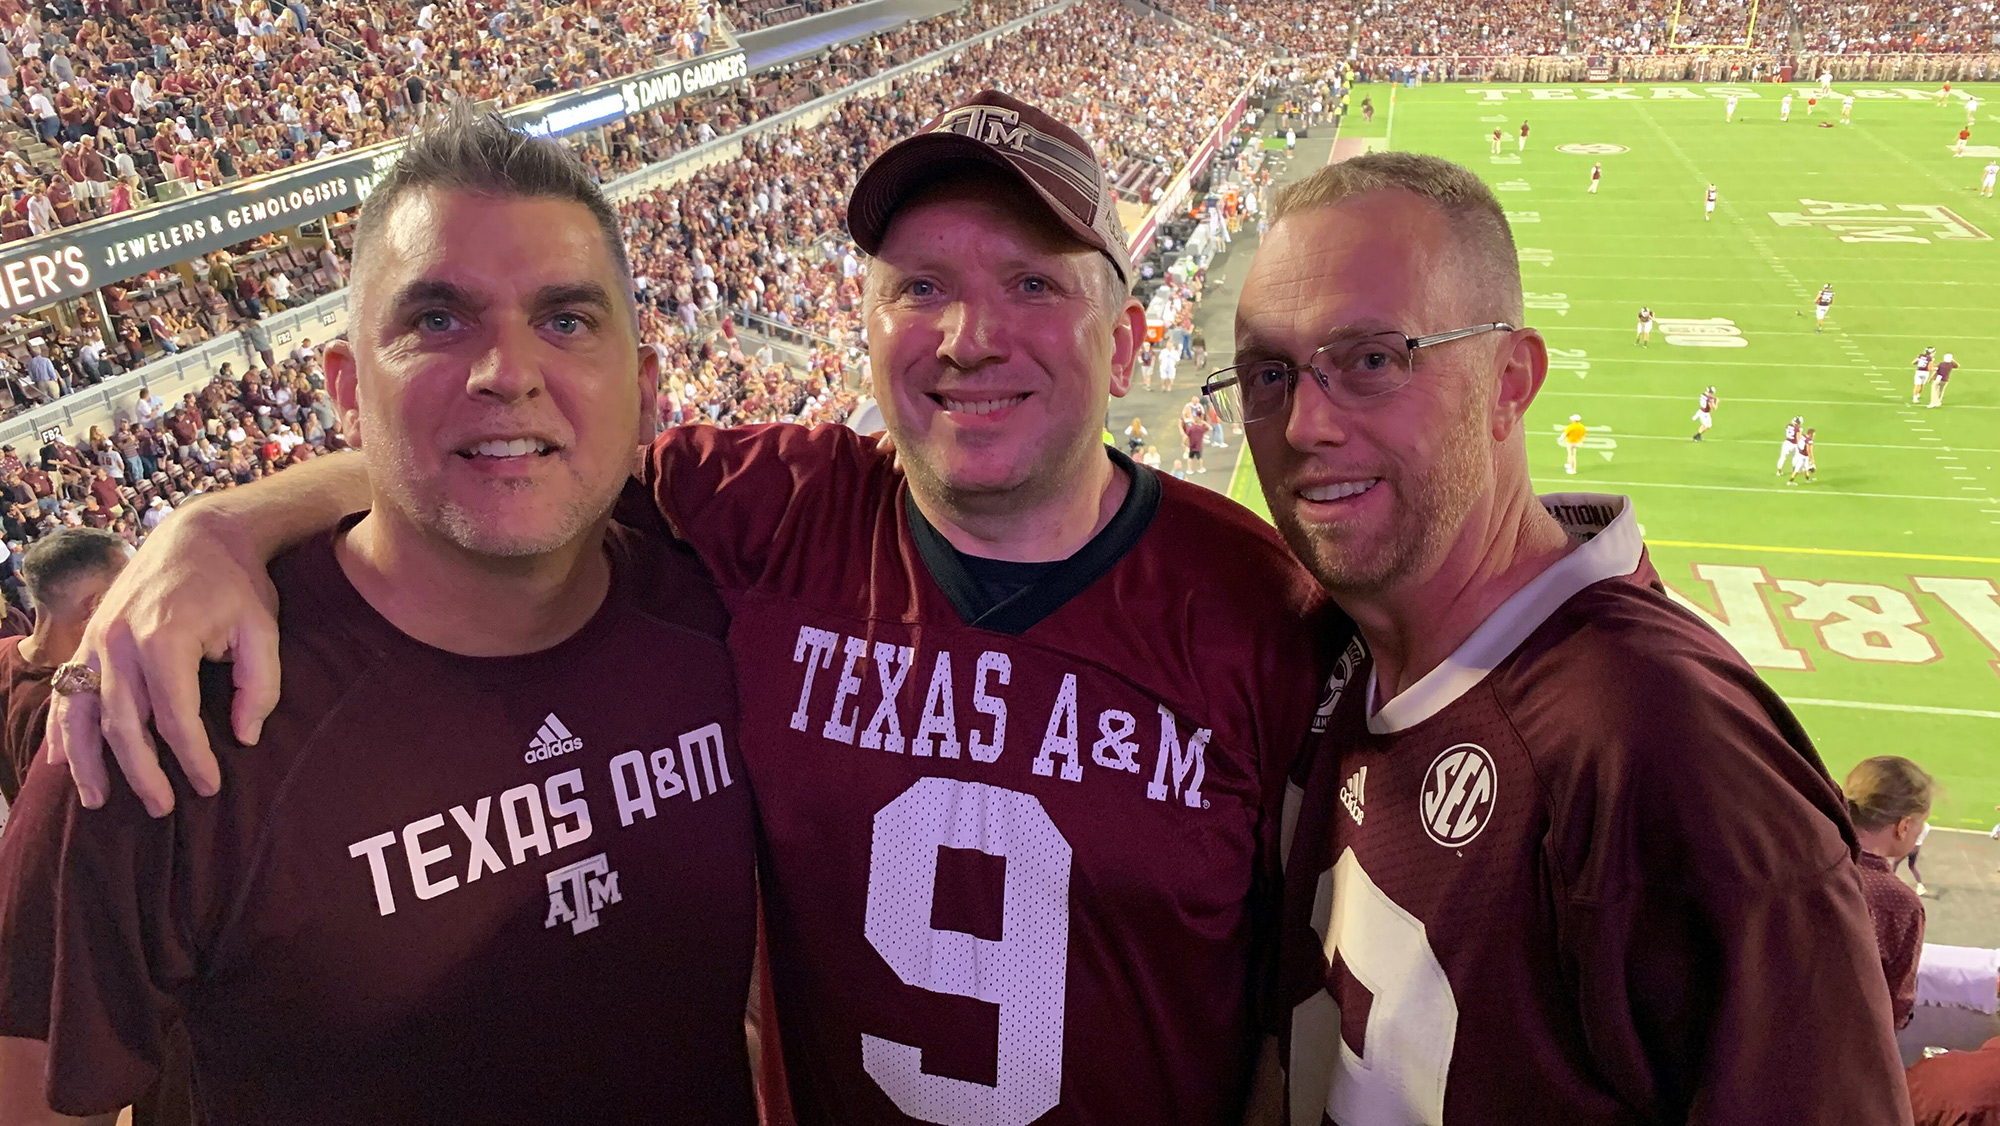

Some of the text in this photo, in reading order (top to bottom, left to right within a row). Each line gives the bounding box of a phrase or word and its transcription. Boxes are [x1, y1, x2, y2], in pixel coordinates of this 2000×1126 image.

[639, 72, 681, 107] DAVID
[682, 53, 748, 93] GARDNER'S
[1464, 88, 1762, 100] TEXAS
[105, 224, 206, 267] JEWELERS
[211, 214, 223, 235] &
[227, 177, 348, 229] GEMOLOGISTS
[278, 332, 292, 345] FB2
[41, 426, 61, 443] FB2
[789, 625, 1212, 809] TEXAS A&M
[525, 737, 583, 764] adidas
[348, 722, 734, 917] TEXAS A&M
[1339, 786, 1364, 826] adidas
[1425, 751, 1491, 839] SEC
[861, 777, 1072, 1126] 9
